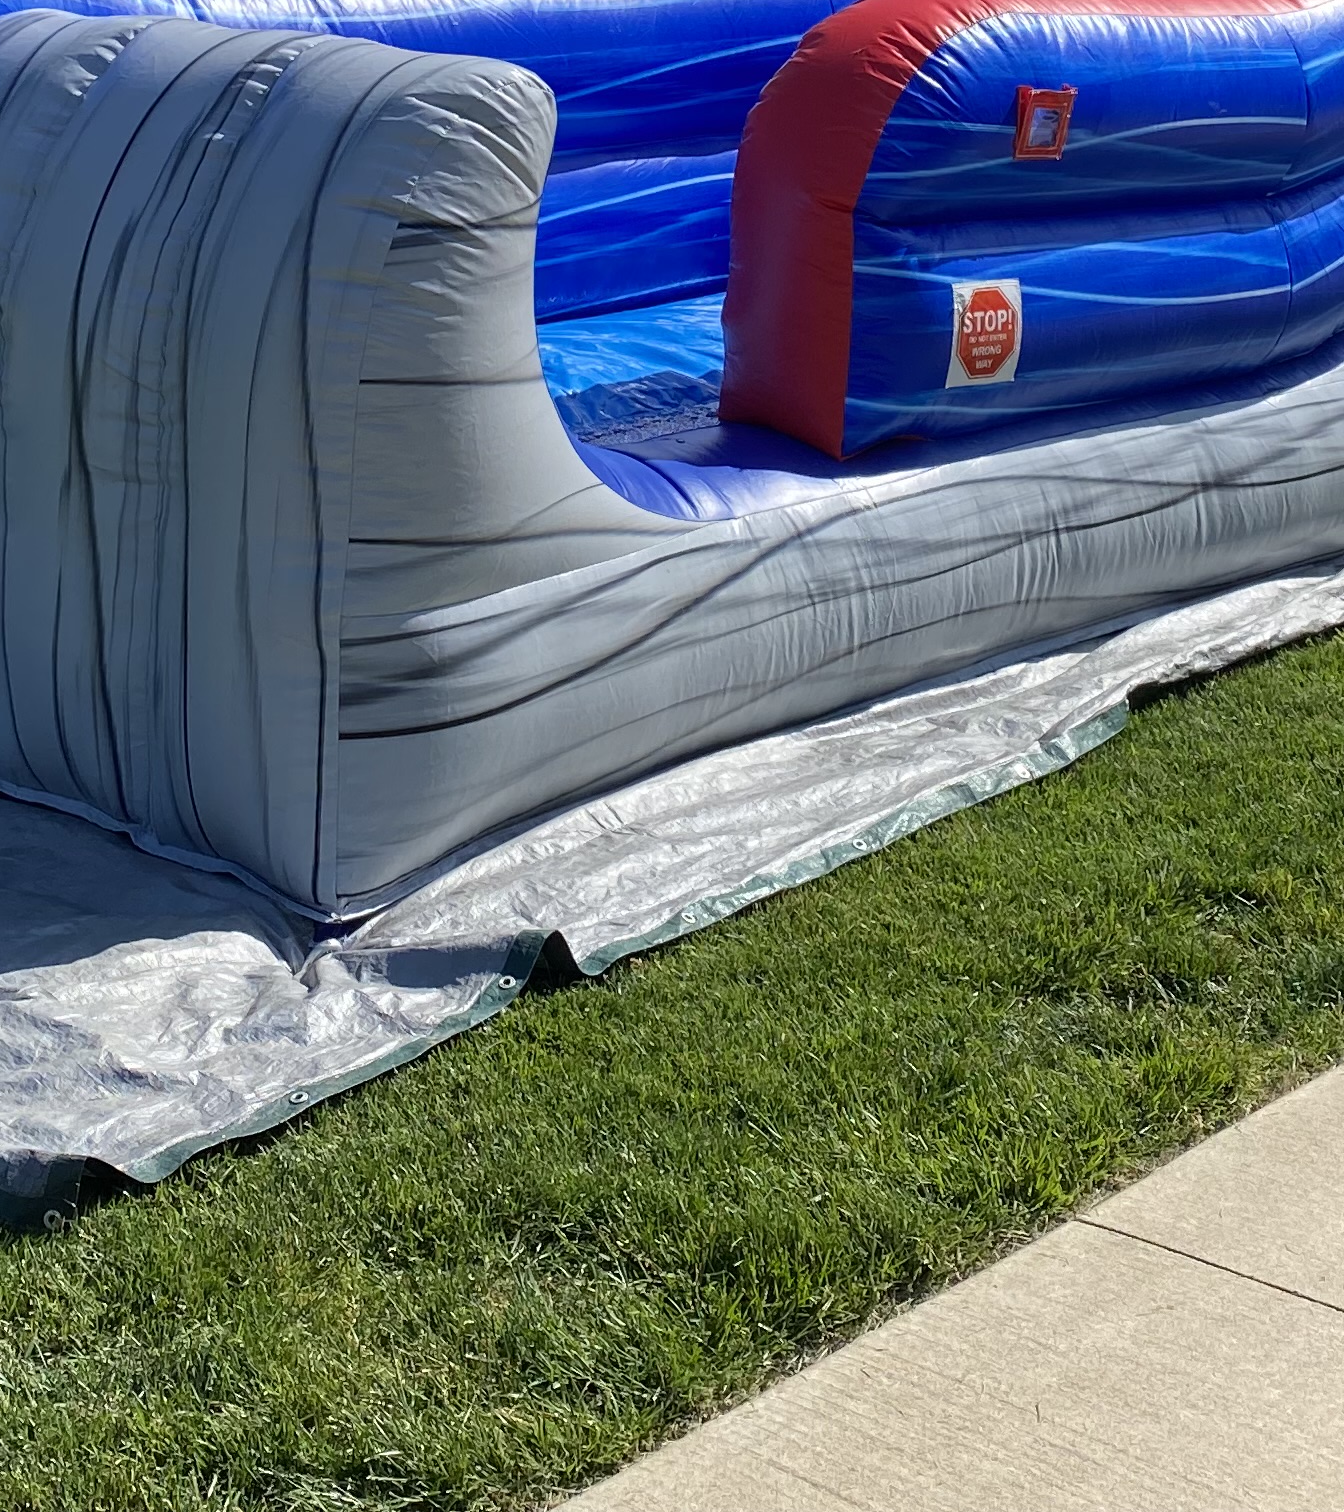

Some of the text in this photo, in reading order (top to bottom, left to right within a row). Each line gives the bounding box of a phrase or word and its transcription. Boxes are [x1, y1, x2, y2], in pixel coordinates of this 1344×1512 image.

[963, 309, 1013, 334] STOP!
[972, 344, 1002, 357] WRONG
[976, 358, 993, 369] WAY
